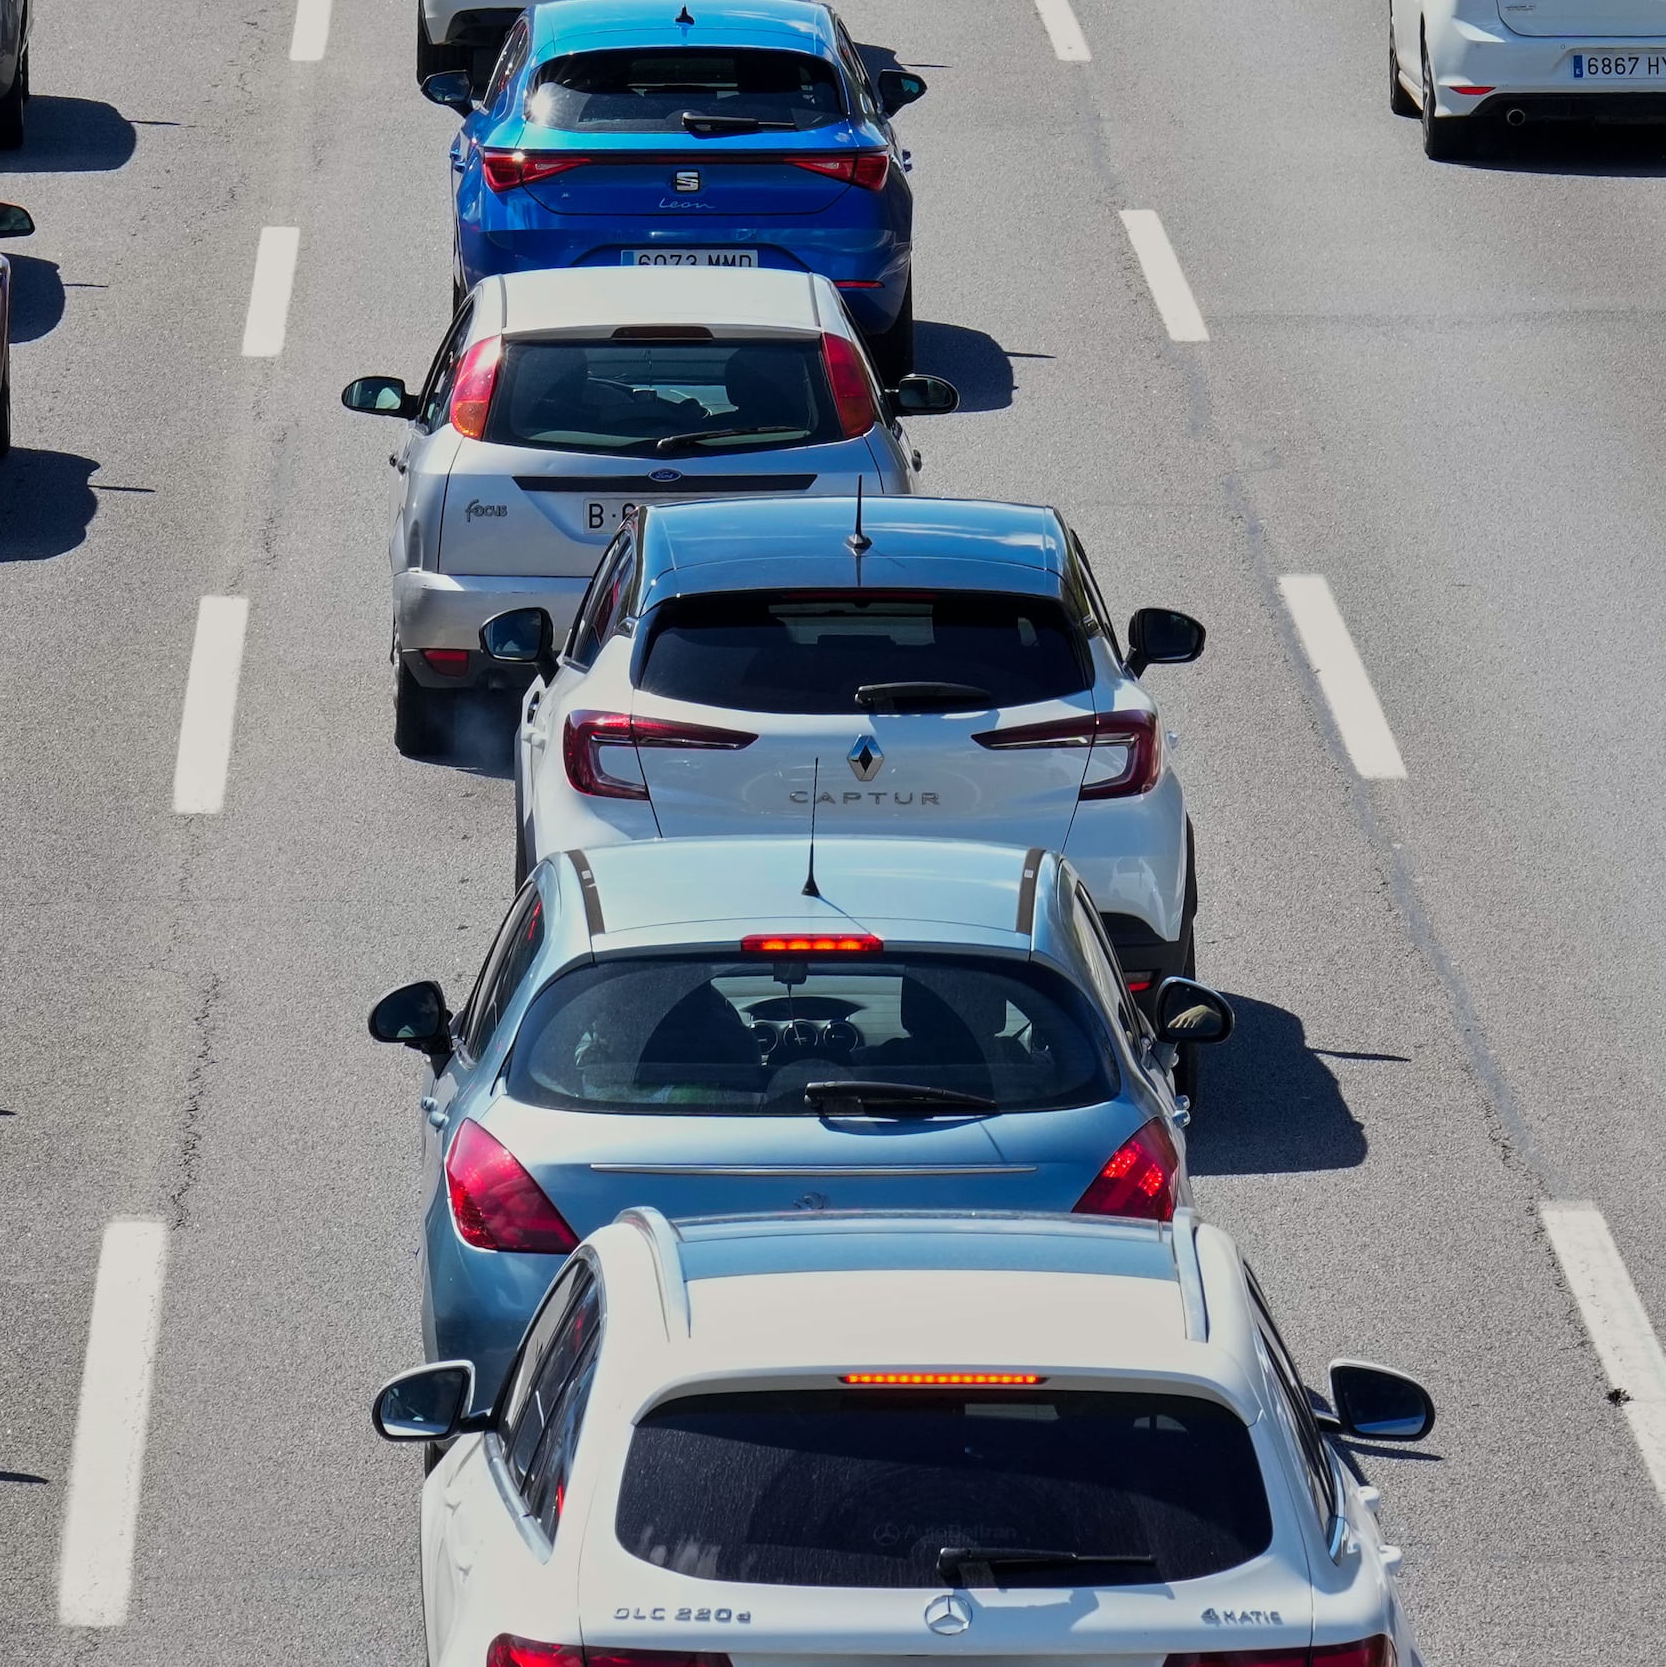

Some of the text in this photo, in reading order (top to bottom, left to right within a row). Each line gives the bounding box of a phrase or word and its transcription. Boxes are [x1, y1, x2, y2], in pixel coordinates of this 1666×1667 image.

[1586, 56, 1639, 76] 6867
[659, 197, 717, 209] Leon
[789, 791, 941, 806] CAPTUR
[613, 1608, 751, 1625] GLC 220d
